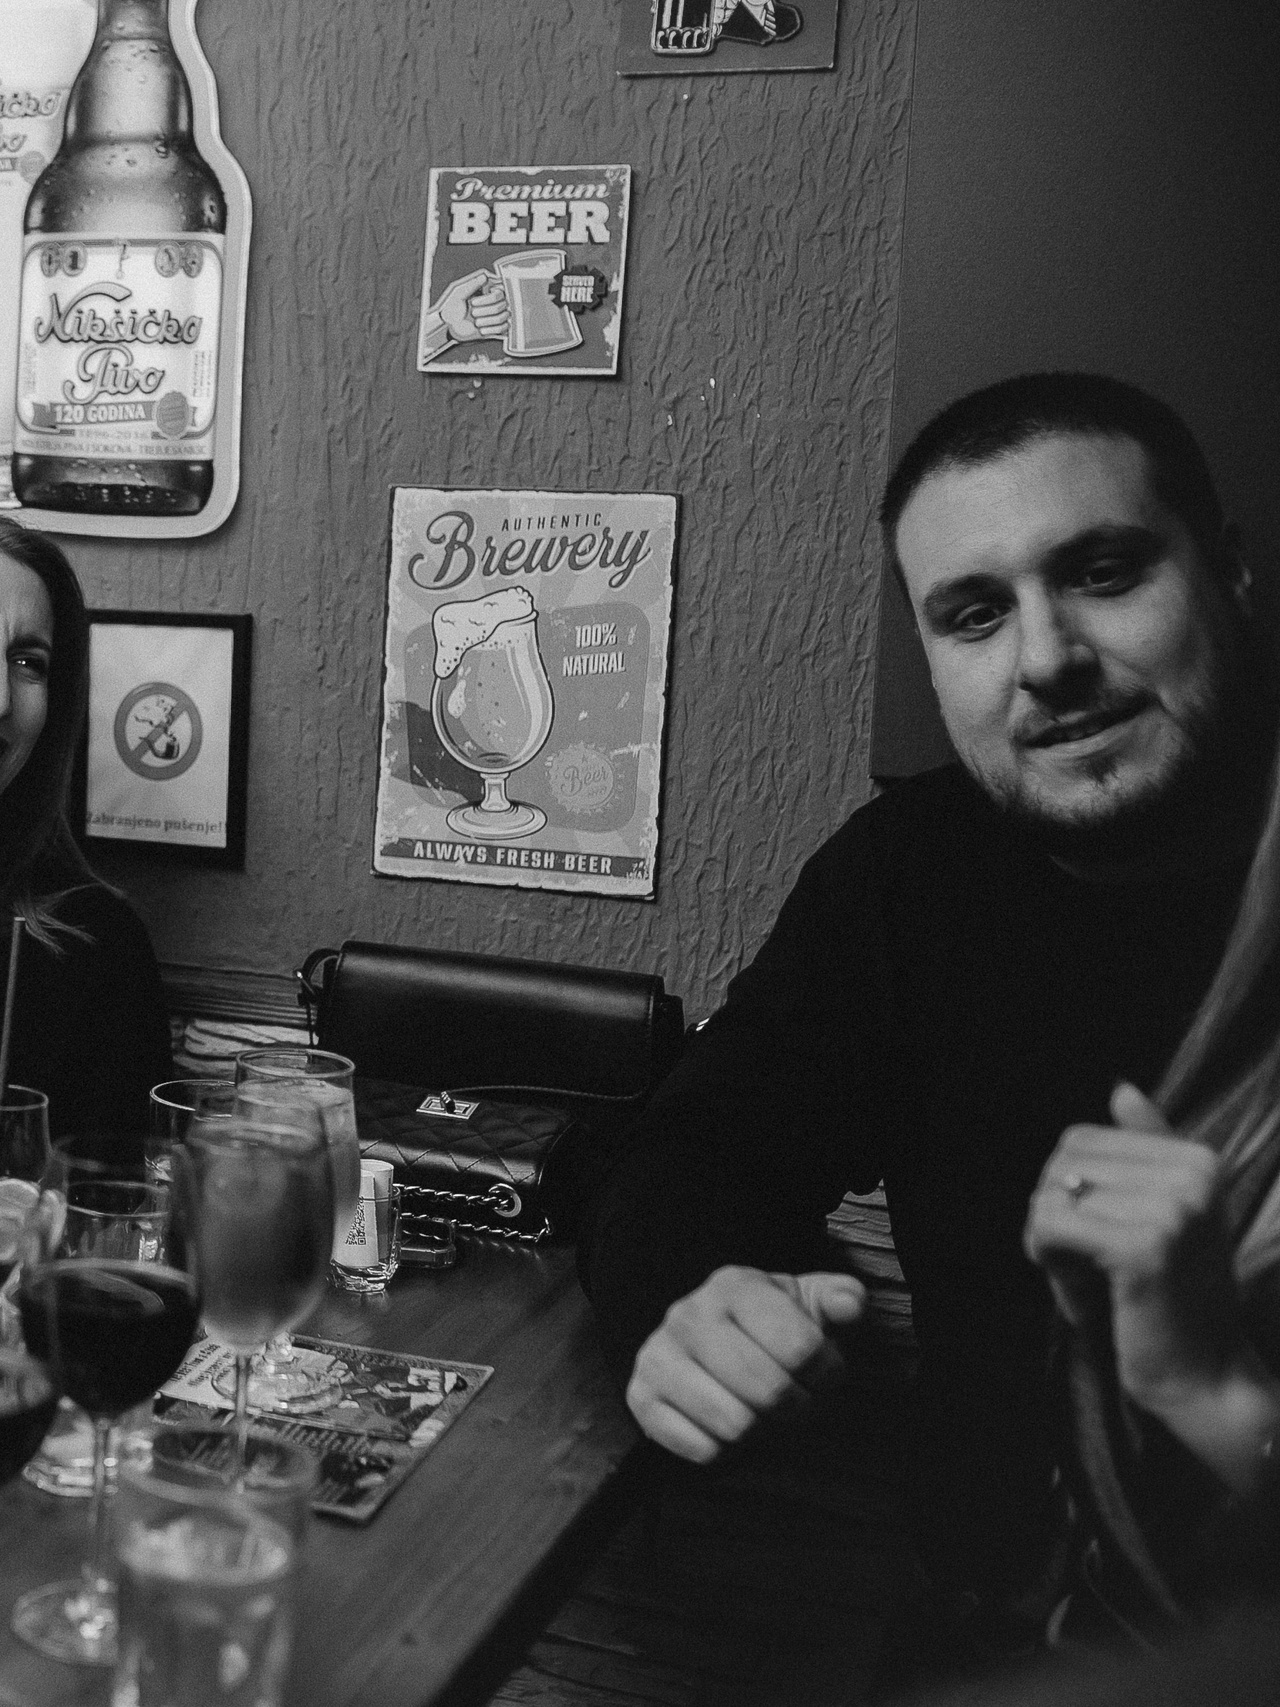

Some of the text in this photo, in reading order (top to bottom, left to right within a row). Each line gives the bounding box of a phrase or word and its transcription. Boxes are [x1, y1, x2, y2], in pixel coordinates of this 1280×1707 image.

[450, 178, 610, 201] Premium
[448, 201, 610, 244] BEER
[562, 275, 595, 286] SERVED
[560, 286, 594, 303] HERE
[63, 345, 166, 404] Pivo
[54, 404, 85, 424] 120
[86, 402, 148, 423] GODINA
[501, 513, 602, 532] AUTHENTIC
[408, 511, 650, 590] Brewery
[573, 623, 618, 648] 100%
[562, 652, 626, 677] NATURAL
[413, 840, 612, 875] ALWAYS FRESH BEER
